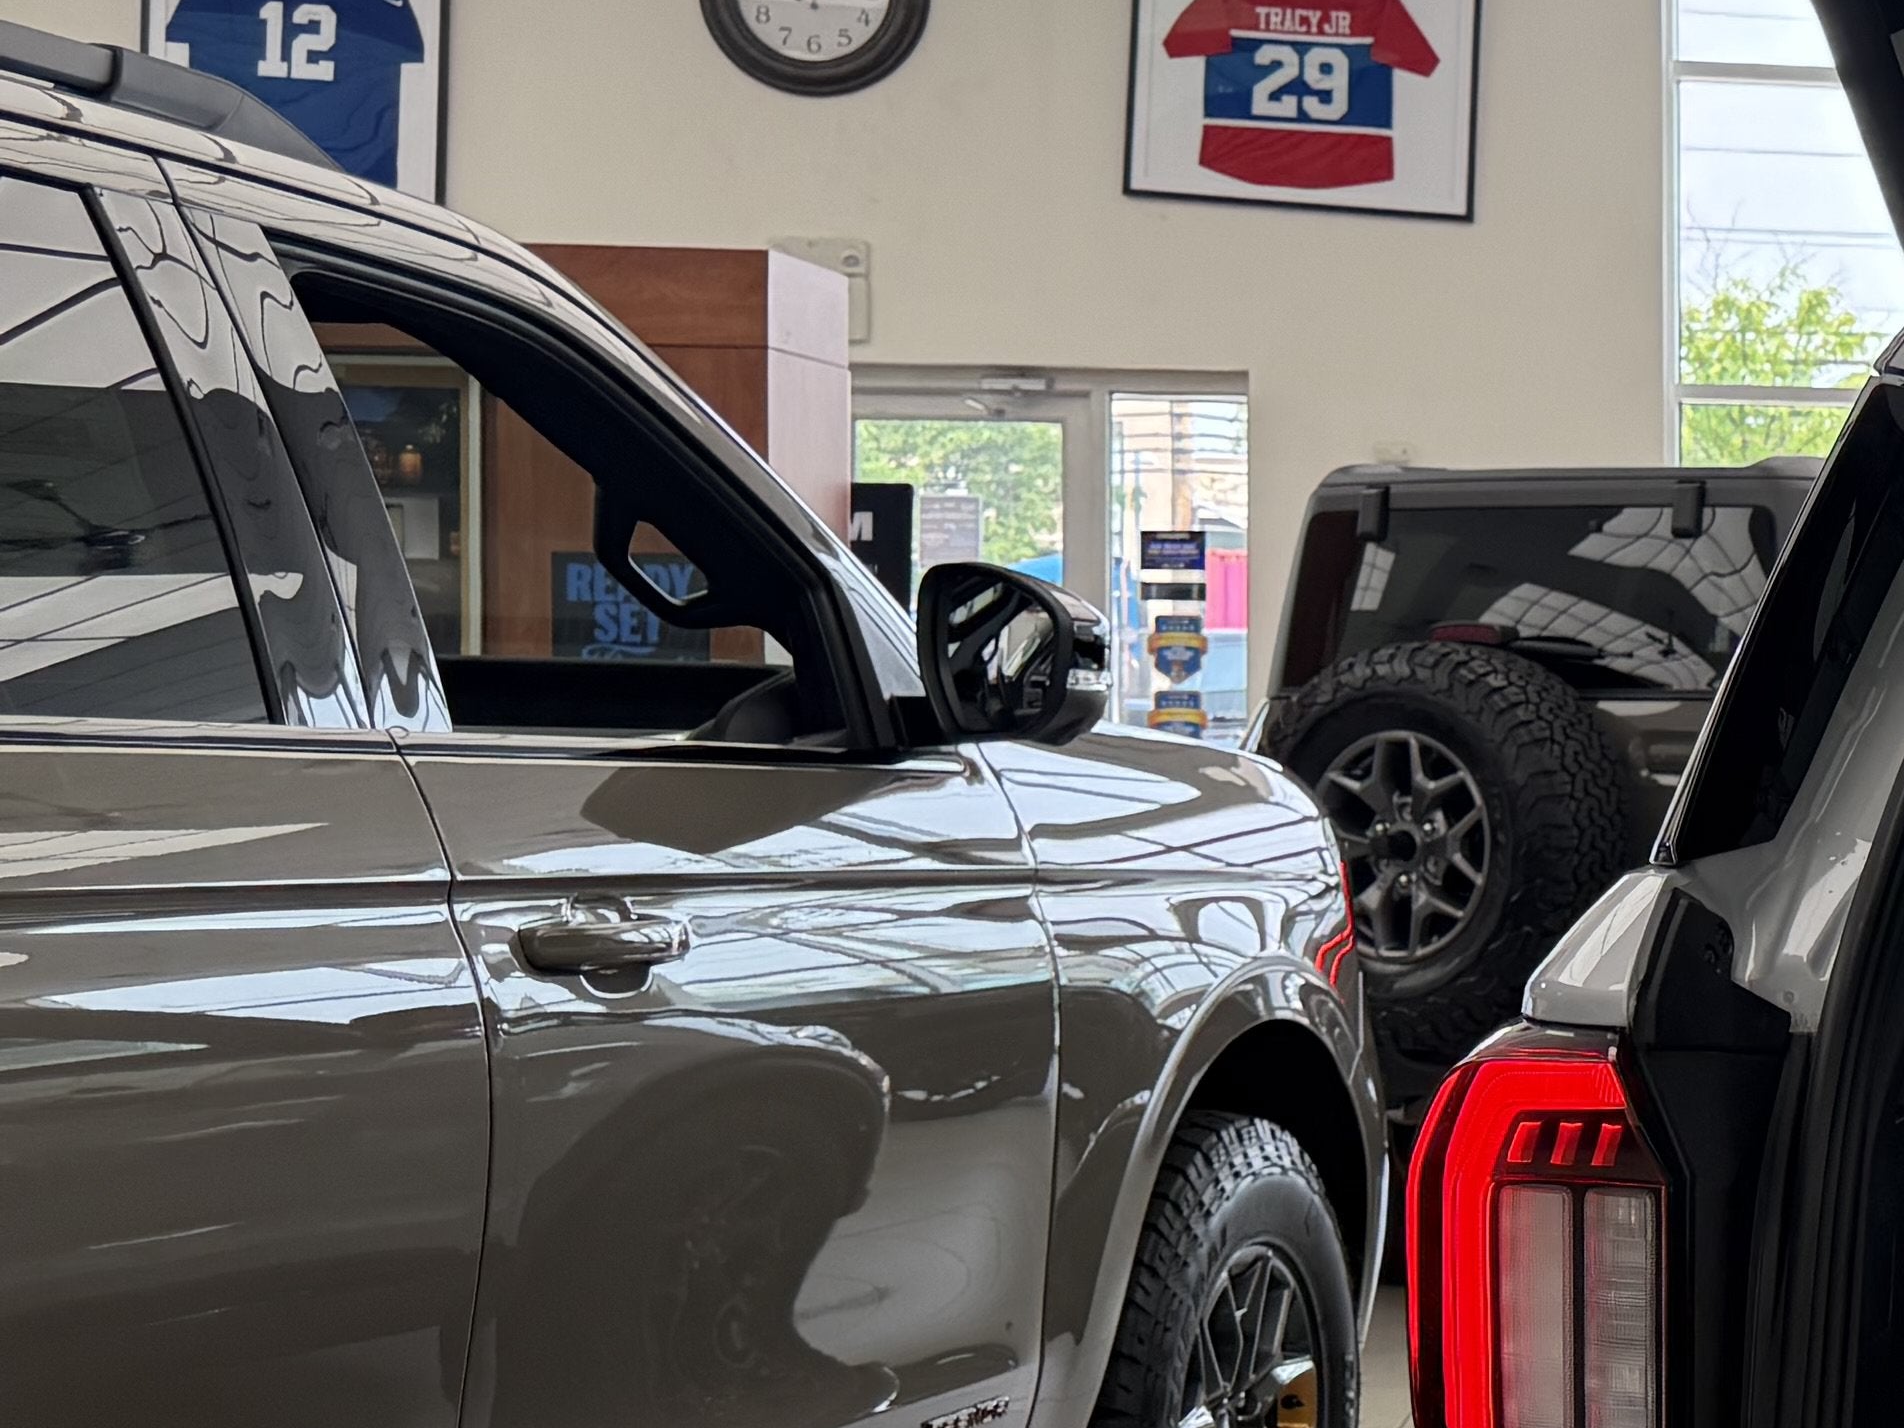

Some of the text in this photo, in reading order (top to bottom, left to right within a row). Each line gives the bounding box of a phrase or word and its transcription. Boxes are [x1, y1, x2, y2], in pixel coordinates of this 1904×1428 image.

[755, 4, 771, 24] 8
[857, 8, 870, 27] 4
[1255, 6, 1351, 34] TRACY JR
[257, 1, 336, 81] 12
[778, 26, 792, 46] 7
[806, 35, 822, 54] 6
[837, 28, 852, 47] 5
[1251, 44, 1349, 121] 29
[566, 562, 694, 603] REDY
[594, 603, 660, 644] SET
